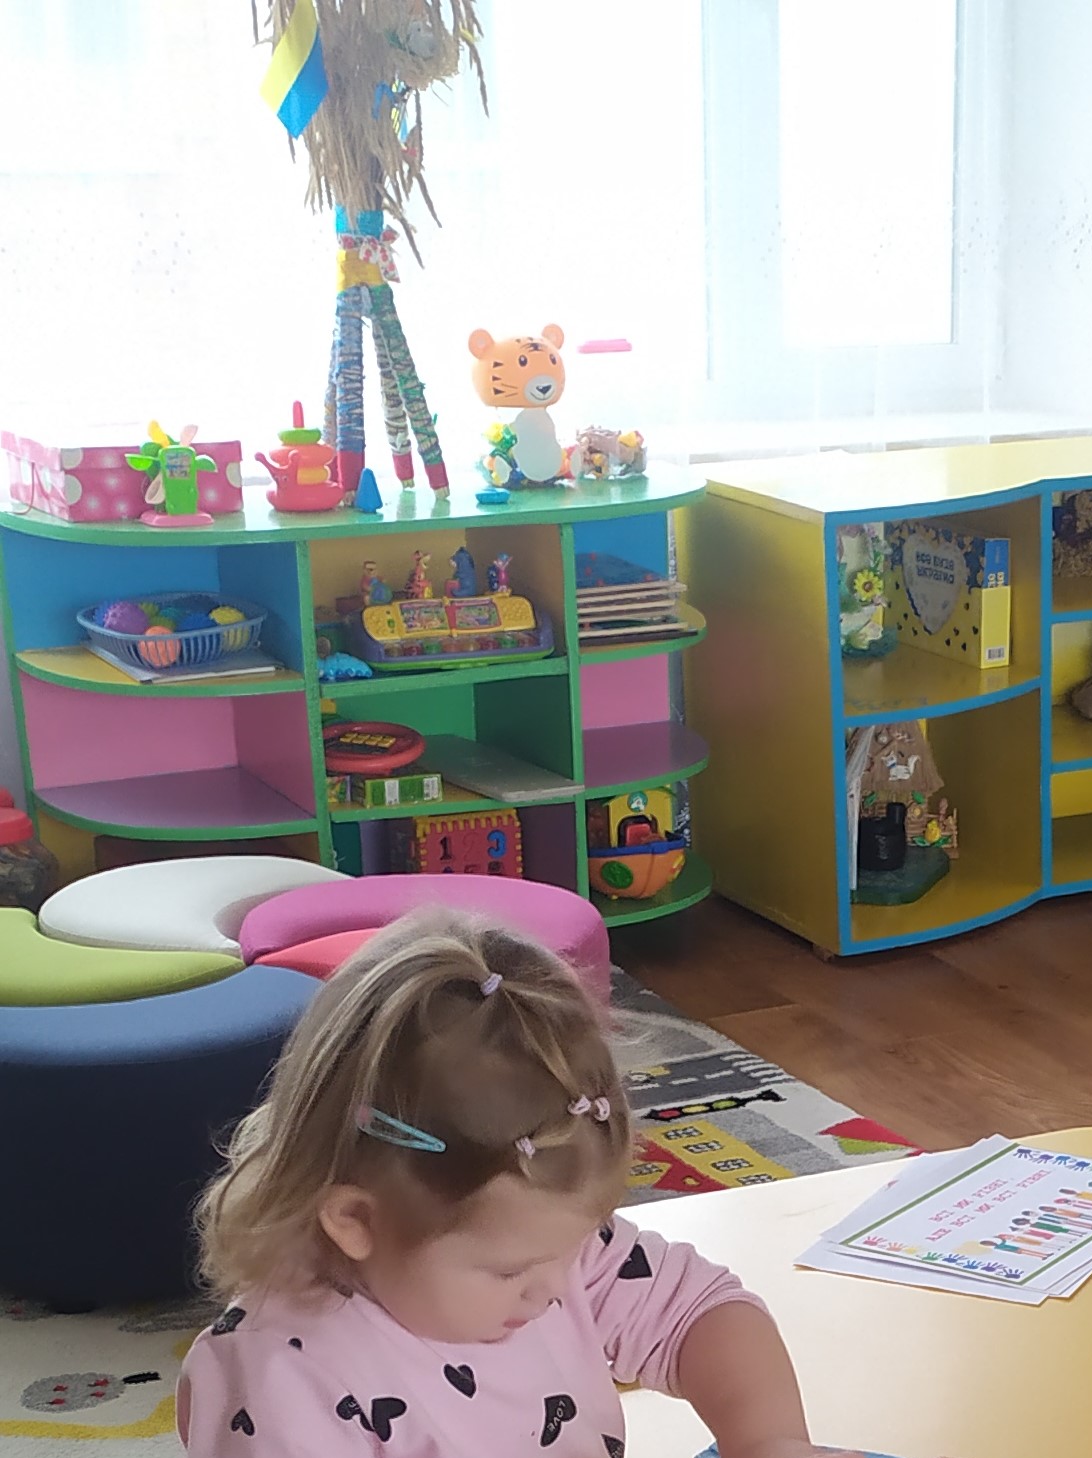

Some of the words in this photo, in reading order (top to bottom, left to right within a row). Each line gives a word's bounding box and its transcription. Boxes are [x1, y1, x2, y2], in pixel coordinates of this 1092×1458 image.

[439, 836, 452, 861] 1
[487, 829, 506, 859] 3
[546, 1400, 566, 1433] LOVE
